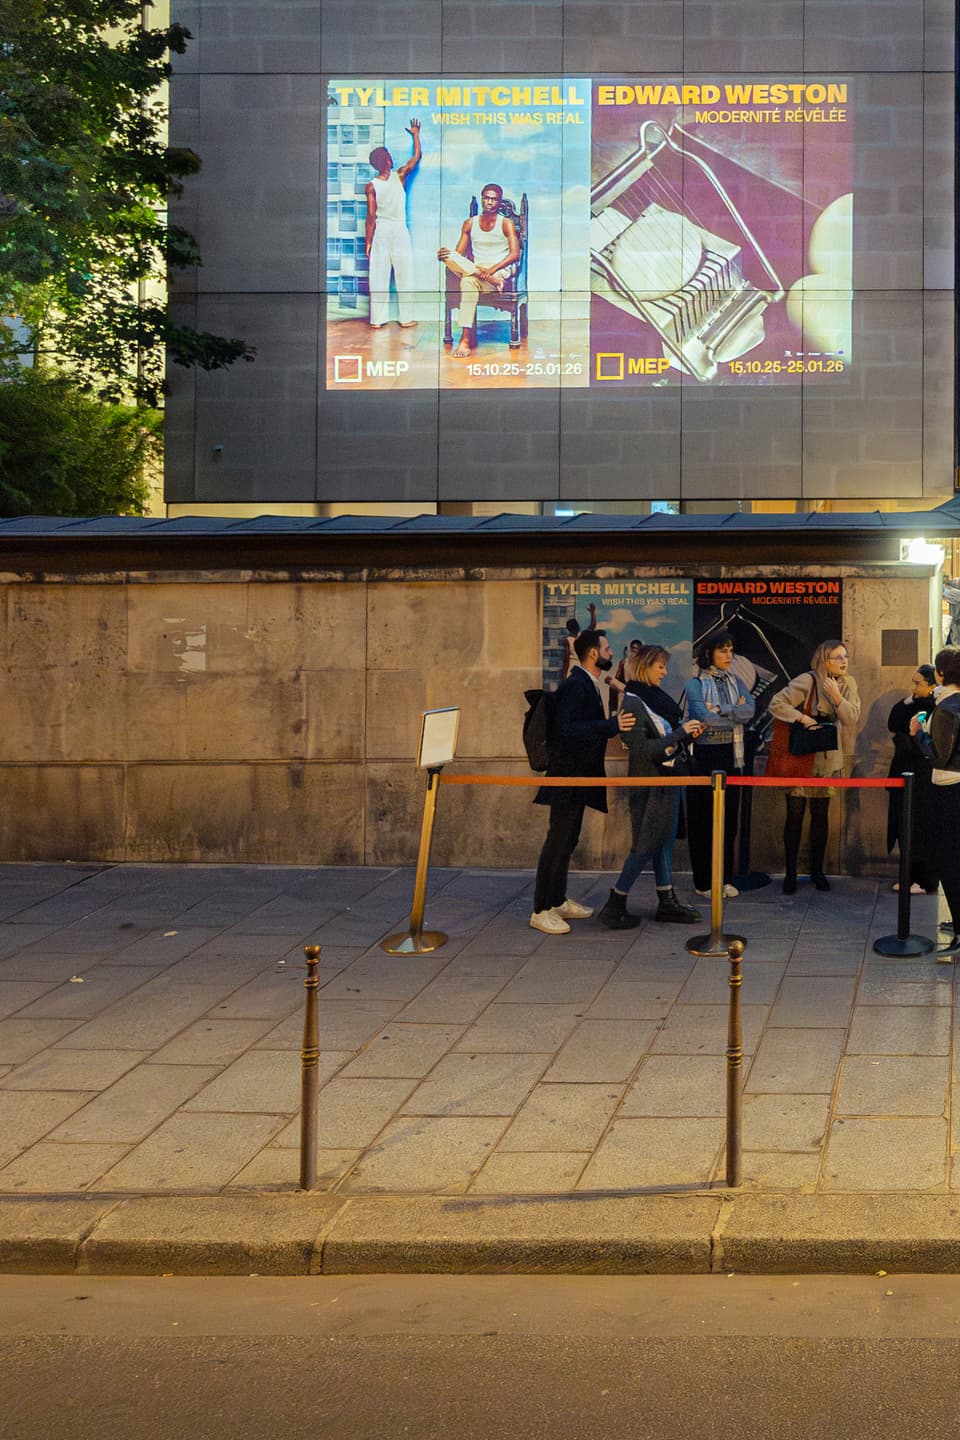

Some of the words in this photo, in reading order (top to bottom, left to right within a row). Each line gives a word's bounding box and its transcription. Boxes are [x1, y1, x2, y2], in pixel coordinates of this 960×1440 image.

[335, 87, 430, 107] TYLER
[436, 86, 584, 106] MITCHELL
[598, 85, 720, 105] EDWARD
[725, 84, 848, 104] WESTON
[431, 113, 471, 125] WISH
[472, 113, 507, 125] THIS
[508, 113, 544, 125] WAS
[546, 112, 584, 124] REAL
[695, 107, 780, 123] MODERNITÉ
[785, 107, 847, 122] RÉVÉLÉE
[366, 361, 409, 377] MEP
[466, 363, 582, 376] 15.10.25-25.01.26
[628, 358, 670, 374] MEP
[728, 361, 844, 373] 15.10.25-25.01.26
[547, 583, 601, 595] TYLER
[604, 582, 689, 595] MITCHELL
[697, 582, 767, 594] EDWARD
[769, 581, 840, 594] WESTON
[601, 597, 625, 606] WISH
[625, 598, 645, 606] THIS
[646, 597, 666, 605] WAS
[667, 597, 689, 605] REAL
